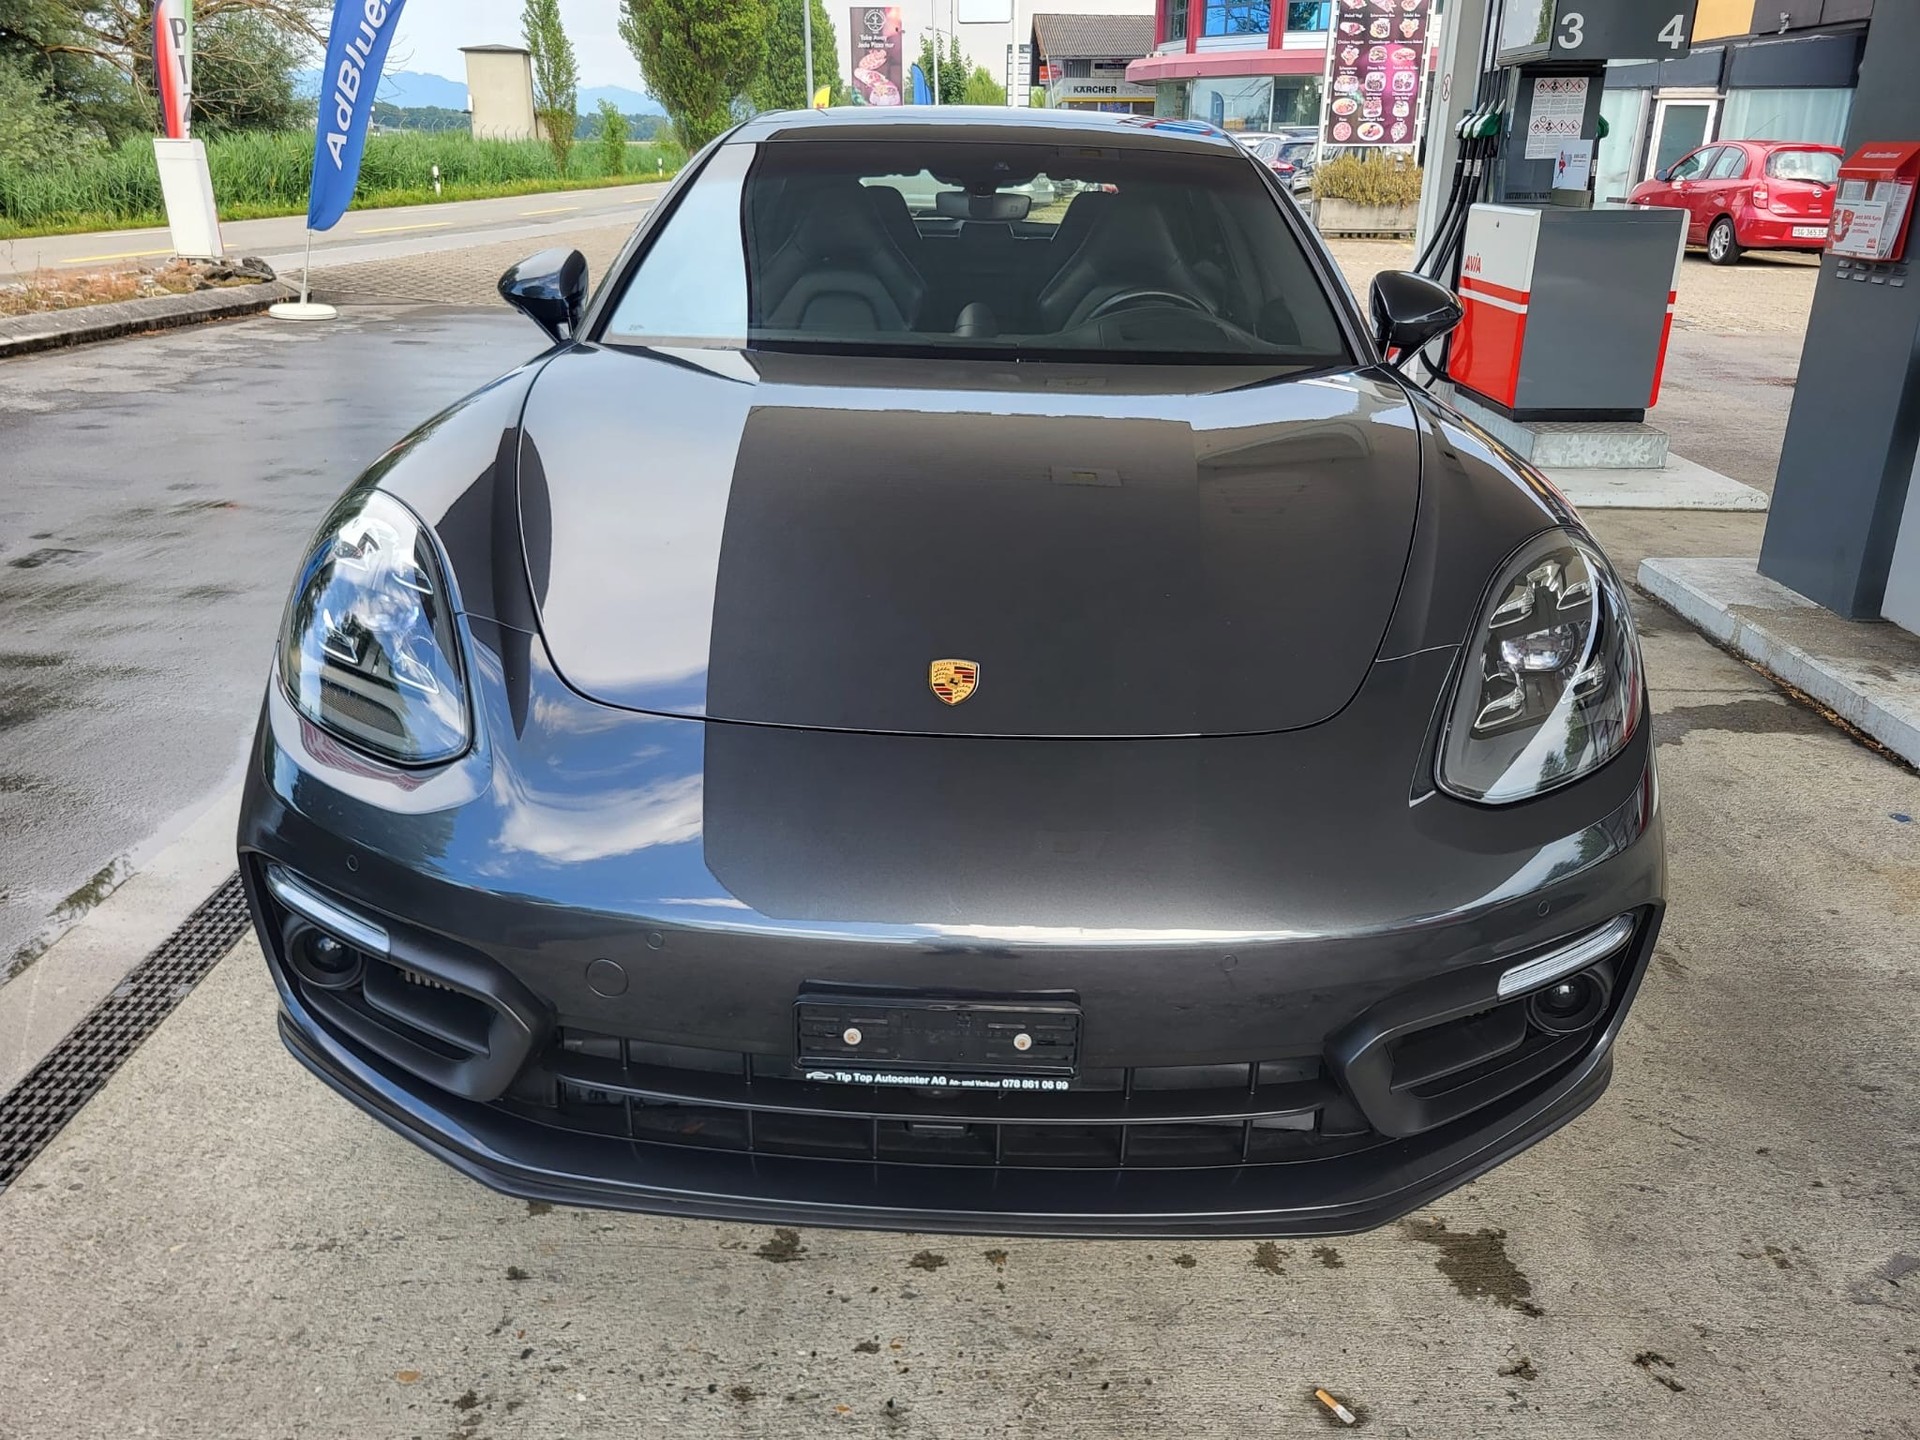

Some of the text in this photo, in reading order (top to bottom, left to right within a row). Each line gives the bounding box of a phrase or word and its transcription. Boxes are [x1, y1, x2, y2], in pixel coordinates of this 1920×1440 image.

[1557, 12, 1685, 50] 3 4
[326, 0, 392, 171] AdBlue
[1073, 85, 1117, 94] KÄRCHER
[1465, 254, 1482, 274] AVIA
[835, 1072, 852, 1083] Tip
[853, 1072, 872, 1084] Top
[874, 1073, 930, 1085] Autocenter
[930, 1076, 947, 1085] AG
[1002, 1079, 1020, 1088] 078
